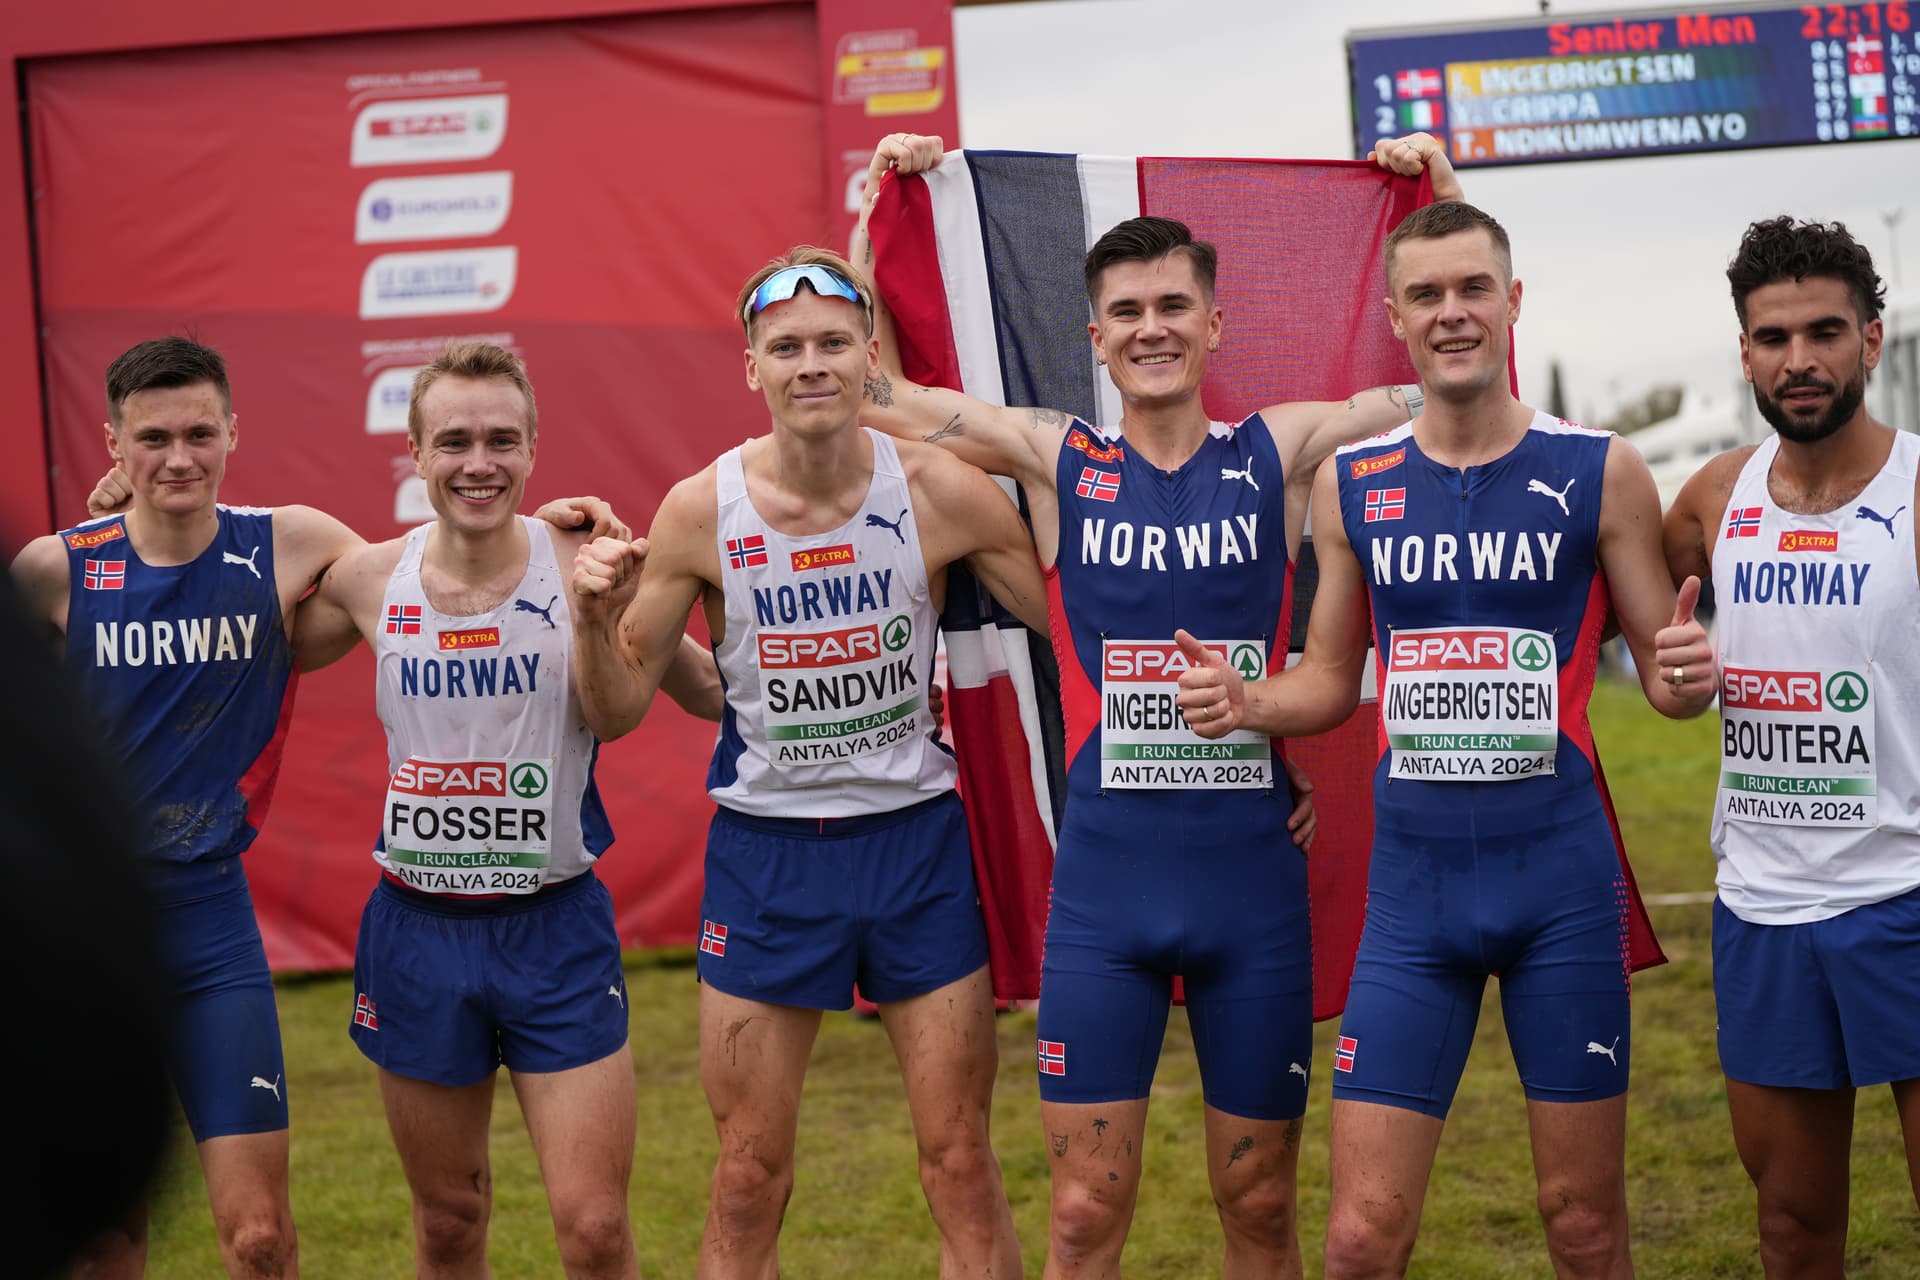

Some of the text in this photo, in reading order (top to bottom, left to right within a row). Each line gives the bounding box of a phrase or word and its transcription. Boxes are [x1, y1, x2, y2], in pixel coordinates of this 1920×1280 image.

[1548, 13, 1757, 56] Senior Men
[1801, 1, 1911, 39] 22:16
[1374, 74, 1392, 102] 1
[1480, 54, 1695, 93] INGEBRIGTSEN
[1375, 105, 1397, 134] 2
[1491, 92, 1601, 124] CRIPPA
[1493, 113, 1747, 156] NDIKUMWENAYO
[1371, 453, 1403, 471] EXTRA
[86, 528, 120, 544] EXTRA
[1082, 514, 1258, 571] NORWAY
[1798, 536, 1835, 547] EXTRA
[813, 550, 851, 563] EXTRA
[1371, 532, 1563, 586] NORWAY
[754, 568, 892, 627] NORWAY
[1733, 561, 1871, 606] NORWAY
[95, 614, 257, 667] NORWAY
[460, 632, 497, 645] EXTRA
[762, 630, 878, 664] SPAR
[1394, 636, 1505, 665] SPAR
[401, 653, 540, 698] NORWAY
[1107, 650, 1224, 677] SPA
[767, 653, 918, 714] SANDVIK
[1724, 673, 1818, 706] SPAR
[1388, 681, 1552, 721] INGEBRIGTSEN
[779, 718, 916, 761] ANTALYA 2024
[800, 726, 805, 738] I
[808, 724, 841, 737] RUN
[1414, 736, 1419, 749] I
[1421, 736, 1455, 749] RUN
[1724, 718, 1871, 764] BOUTERA
[1135, 746, 1139, 758] I
[1143, 746, 1177, 758] RUN
[1398, 756, 1545, 775] ANTALYA 2024
[393, 763, 503, 792] SPAR
[1111, 765, 1264, 783] ANTALYA 2024
[1743, 776, 1747, 789] I
[1749, 776, 1776, 791] RUN
[391, 802, 547, 842] FOSSER
[1727, 796, 1866, 821] ANTALYA 2024
[416, 853, 421, 864] I
[423, 854, 457, 866] RUN
[399, 867, 541, 889] ANTALYA 2024
